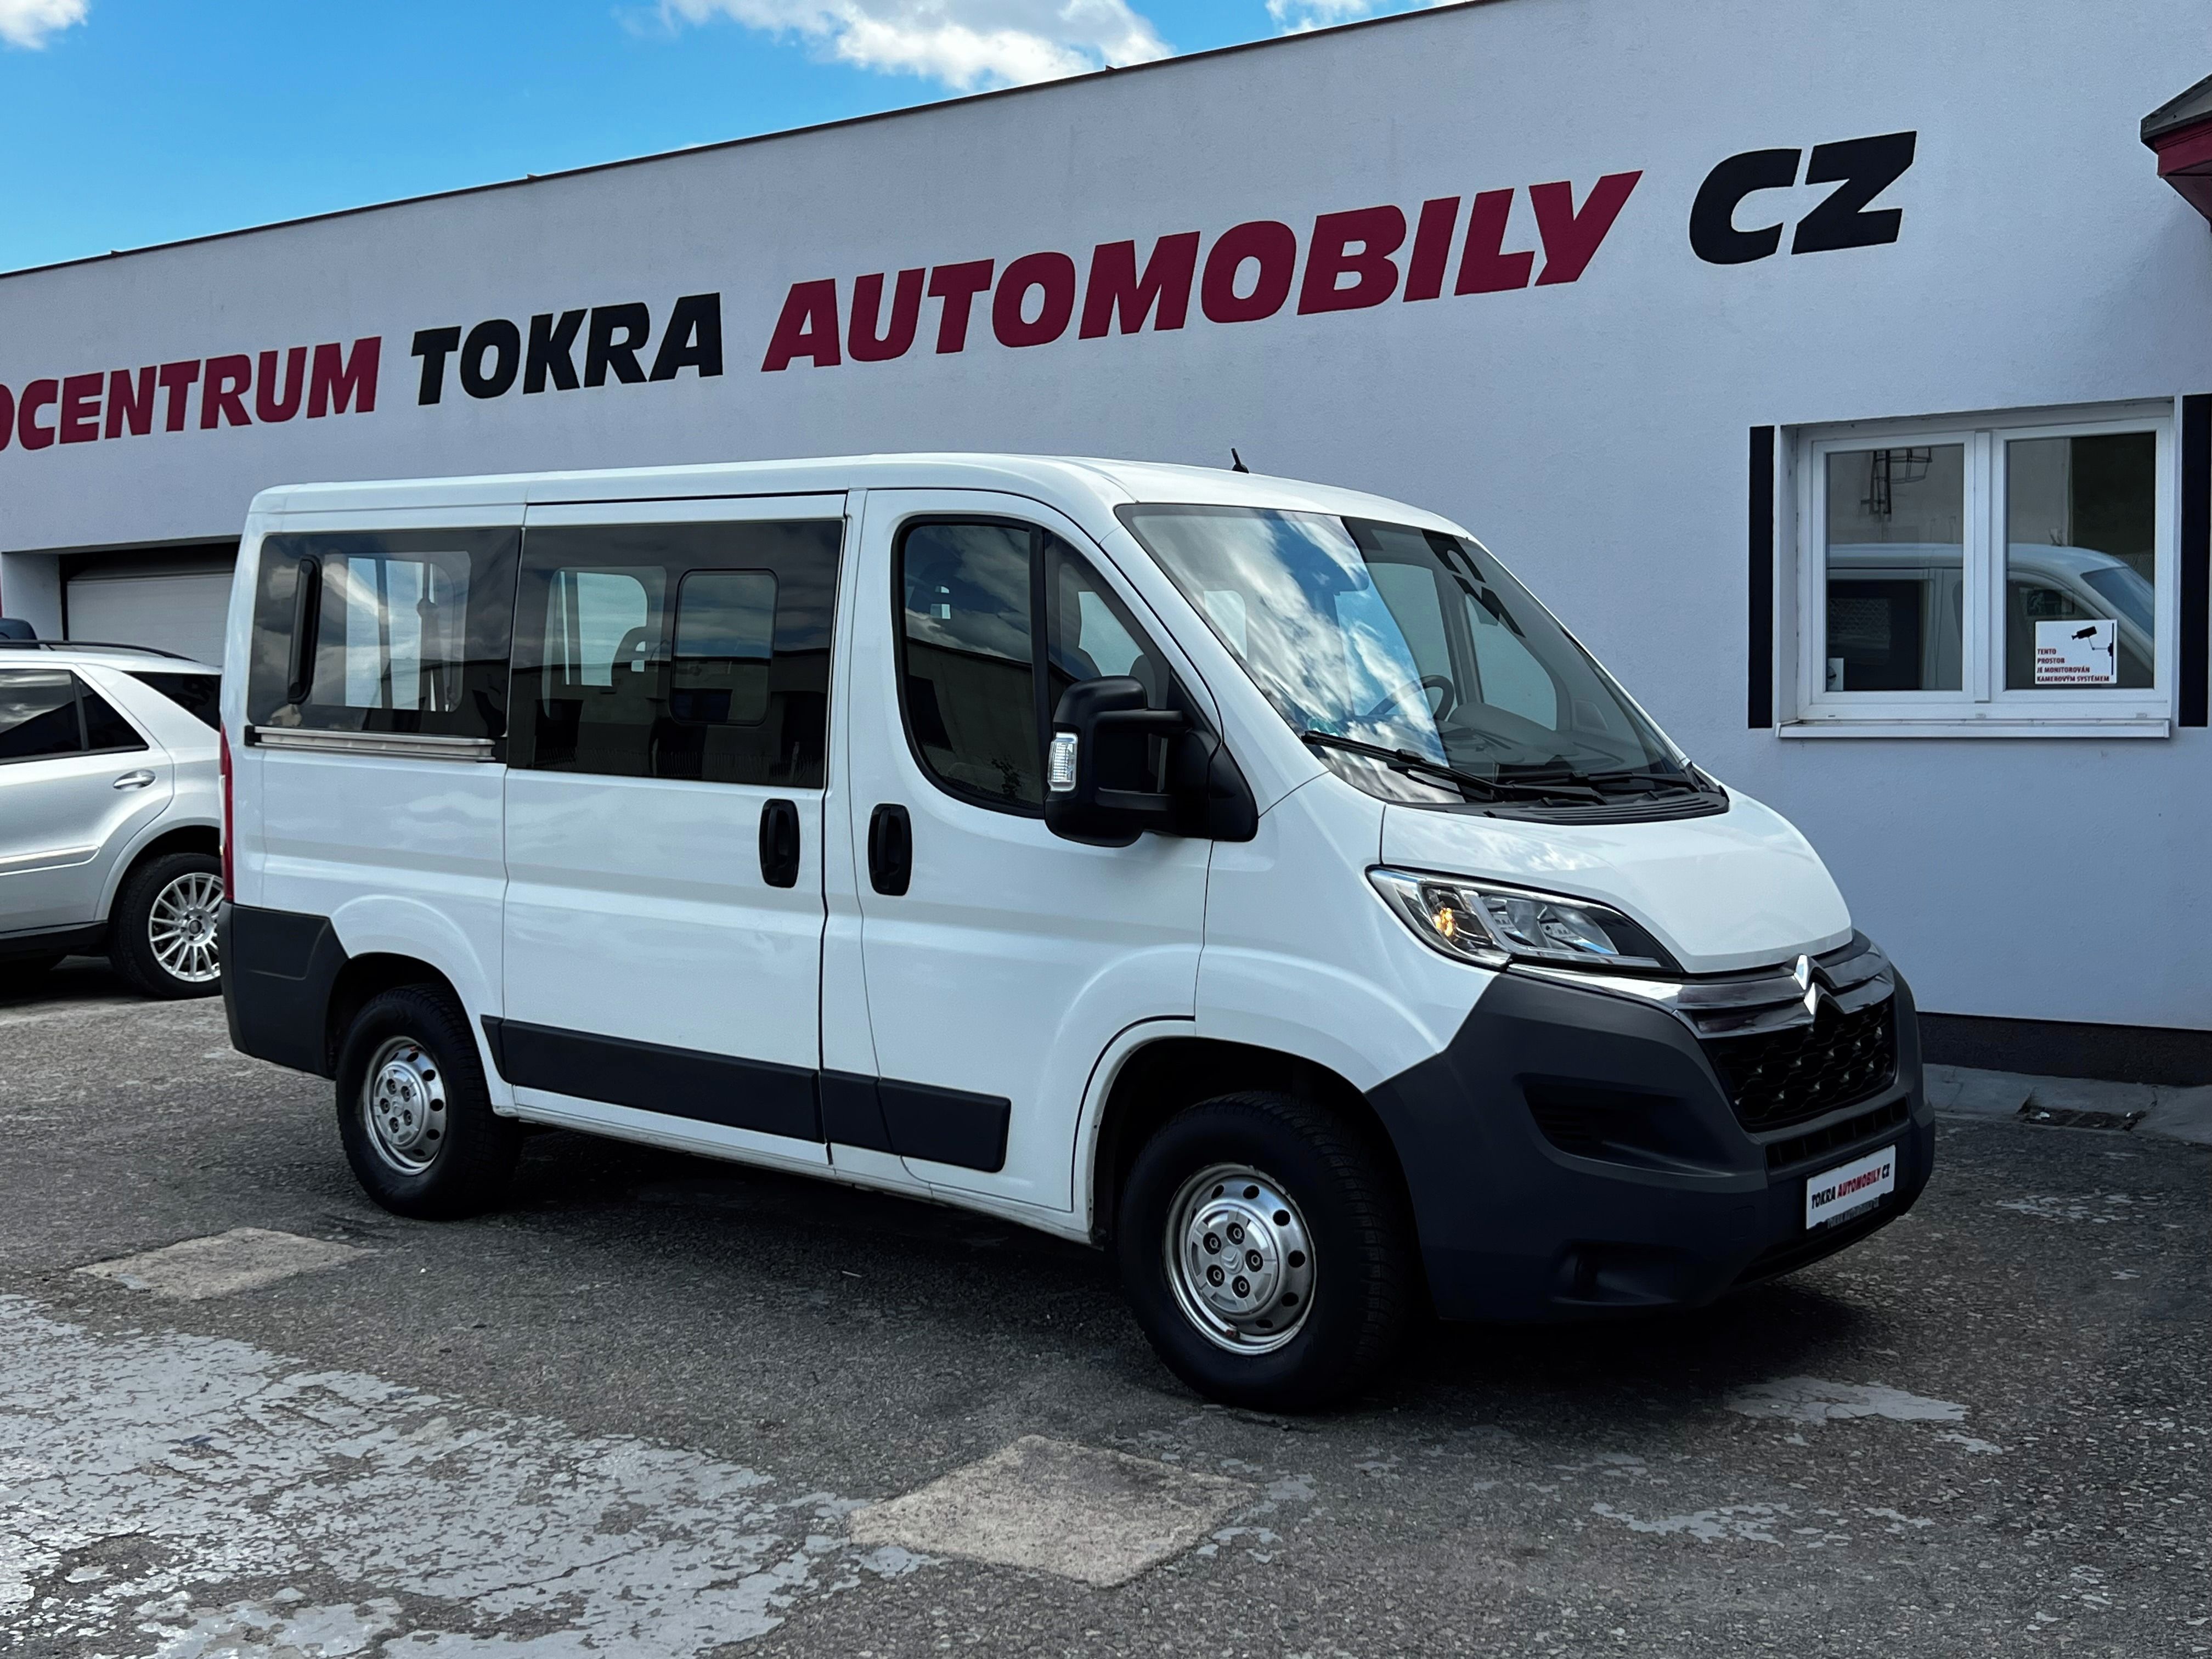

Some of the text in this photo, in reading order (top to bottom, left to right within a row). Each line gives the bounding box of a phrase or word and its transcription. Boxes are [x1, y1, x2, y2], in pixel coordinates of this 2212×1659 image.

[410, 292, 724, 406] TOKRA
[760, 170, 1643, 372] AUTOMOBILY
[1689, 131, 1917, 265] CZ
[2044, 665, 2090, 674] MONITOROVÁN
[1812, 1163, 1891, 1210] TOKRA AUTOMOBILY CZ
